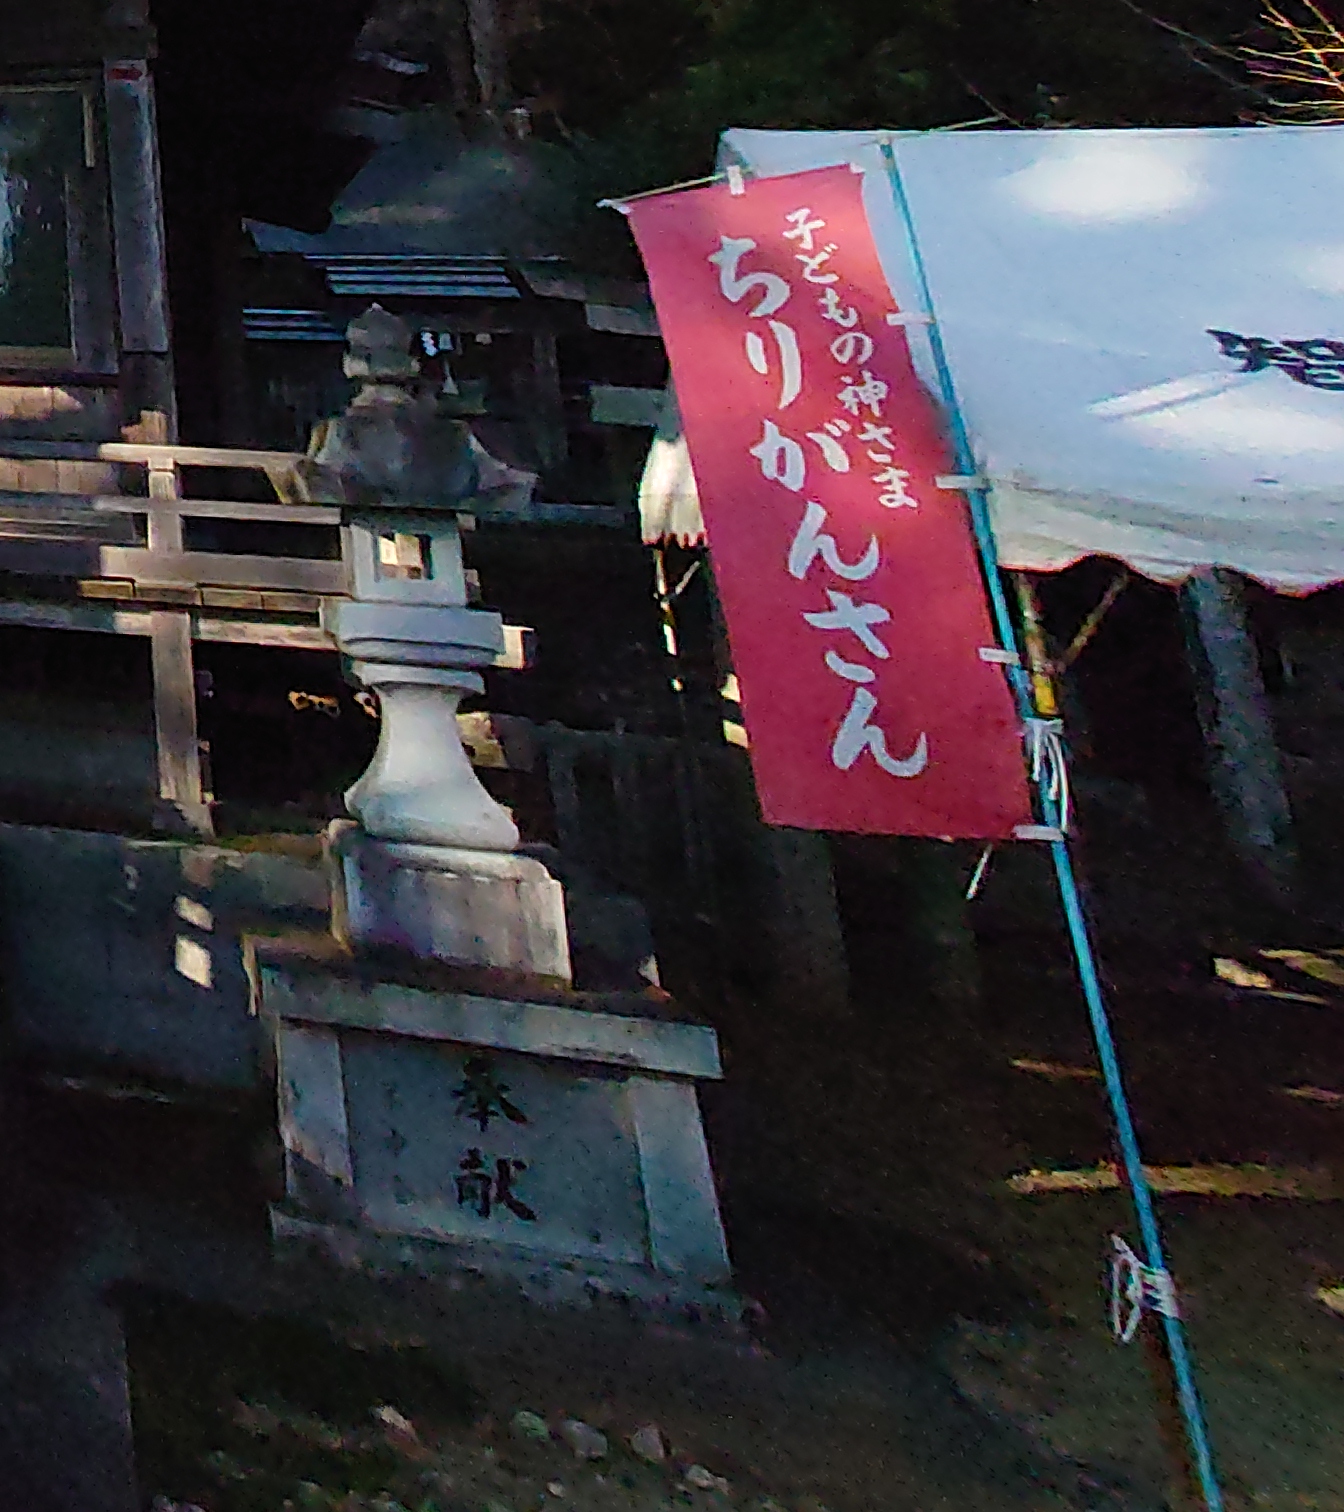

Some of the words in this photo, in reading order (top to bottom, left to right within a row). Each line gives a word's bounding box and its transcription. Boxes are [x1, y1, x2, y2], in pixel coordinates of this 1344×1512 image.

[706, 233, 930, 779] ちりがんさん
[781, 208, 920, 511] 子どもの神さま
